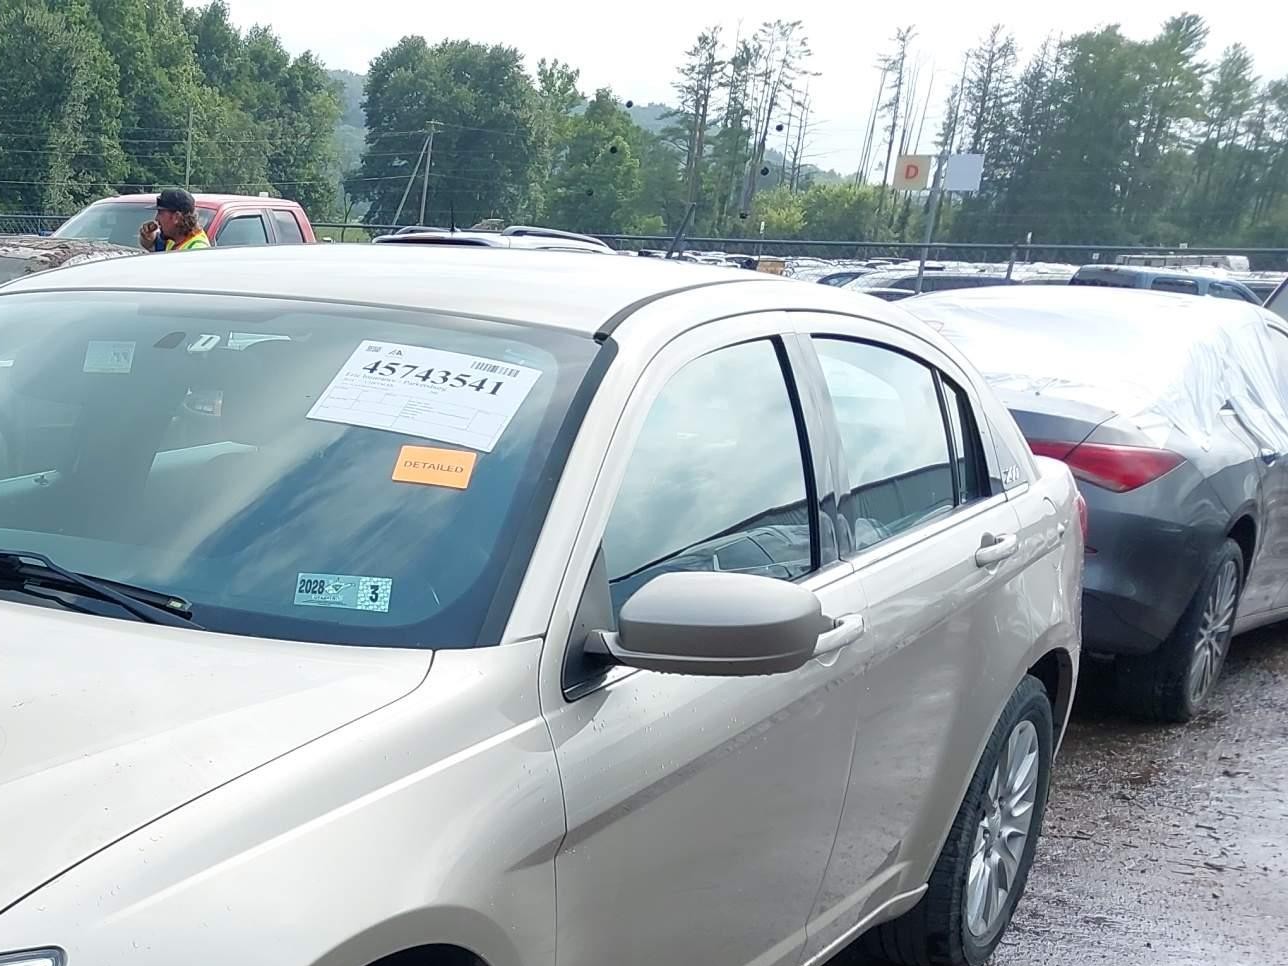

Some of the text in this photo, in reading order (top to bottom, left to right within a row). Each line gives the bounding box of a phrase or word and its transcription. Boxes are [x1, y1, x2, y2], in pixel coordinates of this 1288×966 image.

[905, 164, 919, 179] D
[362, 359, 504, 396] 45743541
[404, 460, 464, 474] DETAILED
[298, 579, 380, 602] 2028 3
